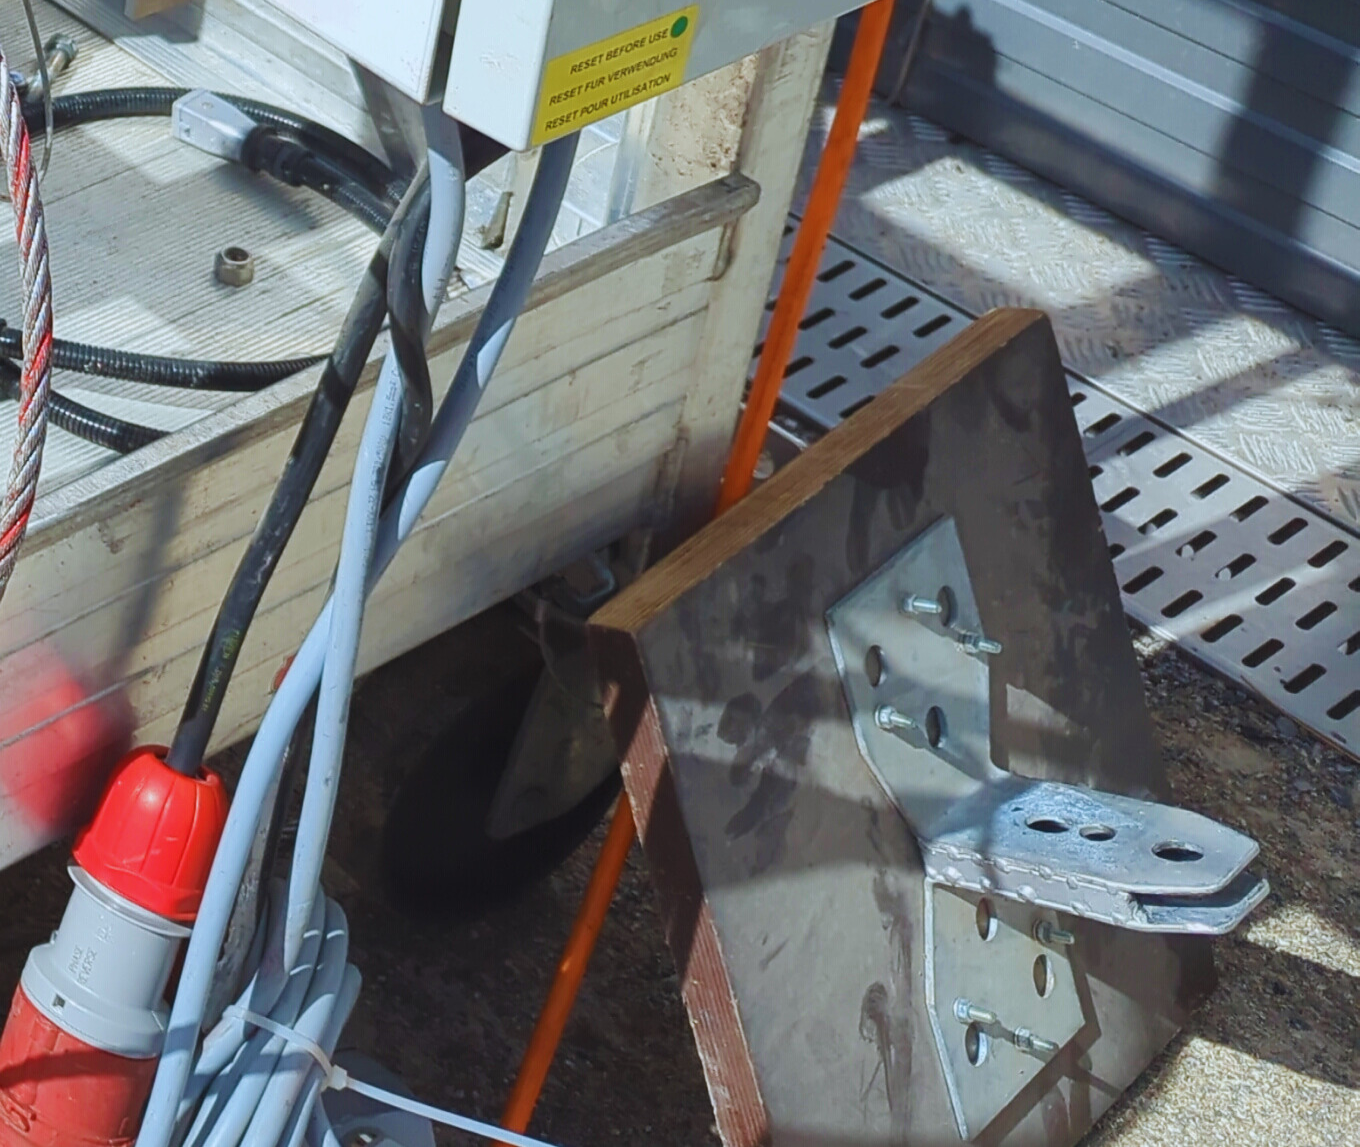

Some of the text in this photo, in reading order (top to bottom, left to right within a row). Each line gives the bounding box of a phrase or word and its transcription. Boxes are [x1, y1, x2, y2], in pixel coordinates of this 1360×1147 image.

[548, 85, 583, 106] RESET
[607, 47, 679, 84] VERWENDUNG
[569, 27, 669, 75] RESET BEFORE USE
[544, 72, 672, 132] RESET POUR UTILISATION
